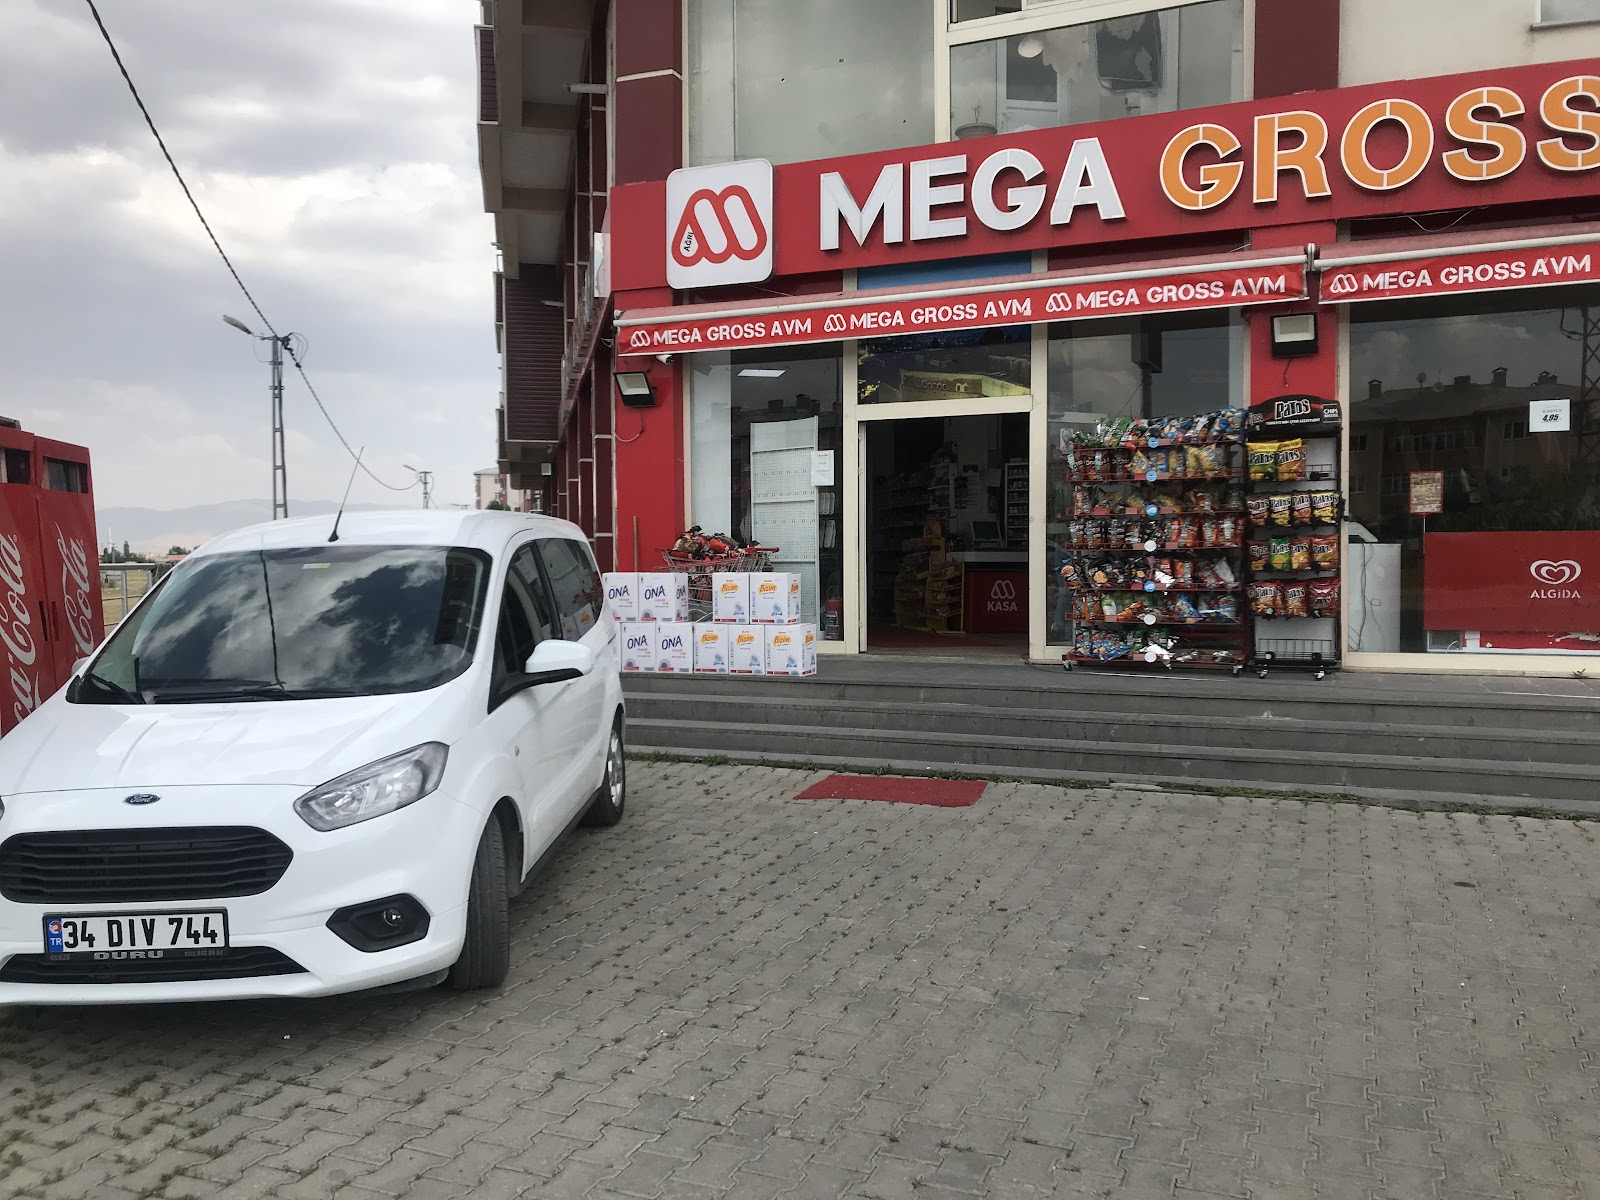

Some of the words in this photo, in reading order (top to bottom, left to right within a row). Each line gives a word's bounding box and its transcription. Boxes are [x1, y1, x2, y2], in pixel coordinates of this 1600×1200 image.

[820, 137, 1126, 250] MEGA
[1159, 75, 1600, 210] GROSS
[683, 231, 694, 252] AĞRI
[1362, 268, 1433, 291] MEGA
[1440, 260, 1526, 285] GROSS
[1531, 254, 1592, 276] AVM
[1075, 287, 1140, 310] MEGA
[1146, 281, 1225, 304] GROSS
[1231, 274, 1286, 297] AVM
[850, 309, 905, 330] MEGA
[910, 303, 978, 325] GROSS
[983, 297, 1032, 319] AVM
[653, 327, 703, 346] MEGA
[706, 322, 766, 341] GROSS
[770, 318, 812, 337] AVM
[608, 585, 629, 600] ONA
[644, 585, 666, 600] ONA
[987, 600, 1018, 612] KASA
[627, 634, 648, 650] ONA
[661, 635, 683, 650] ONA
[129, 794, 153, 804] Ford
[62, 920, 96, 949] 34
[107, 918, 156, 948] DIV
[168, 916, 218, 945] 744
[50, 937, 62, 945] TR
[93, 950, 164, 960] DURU
